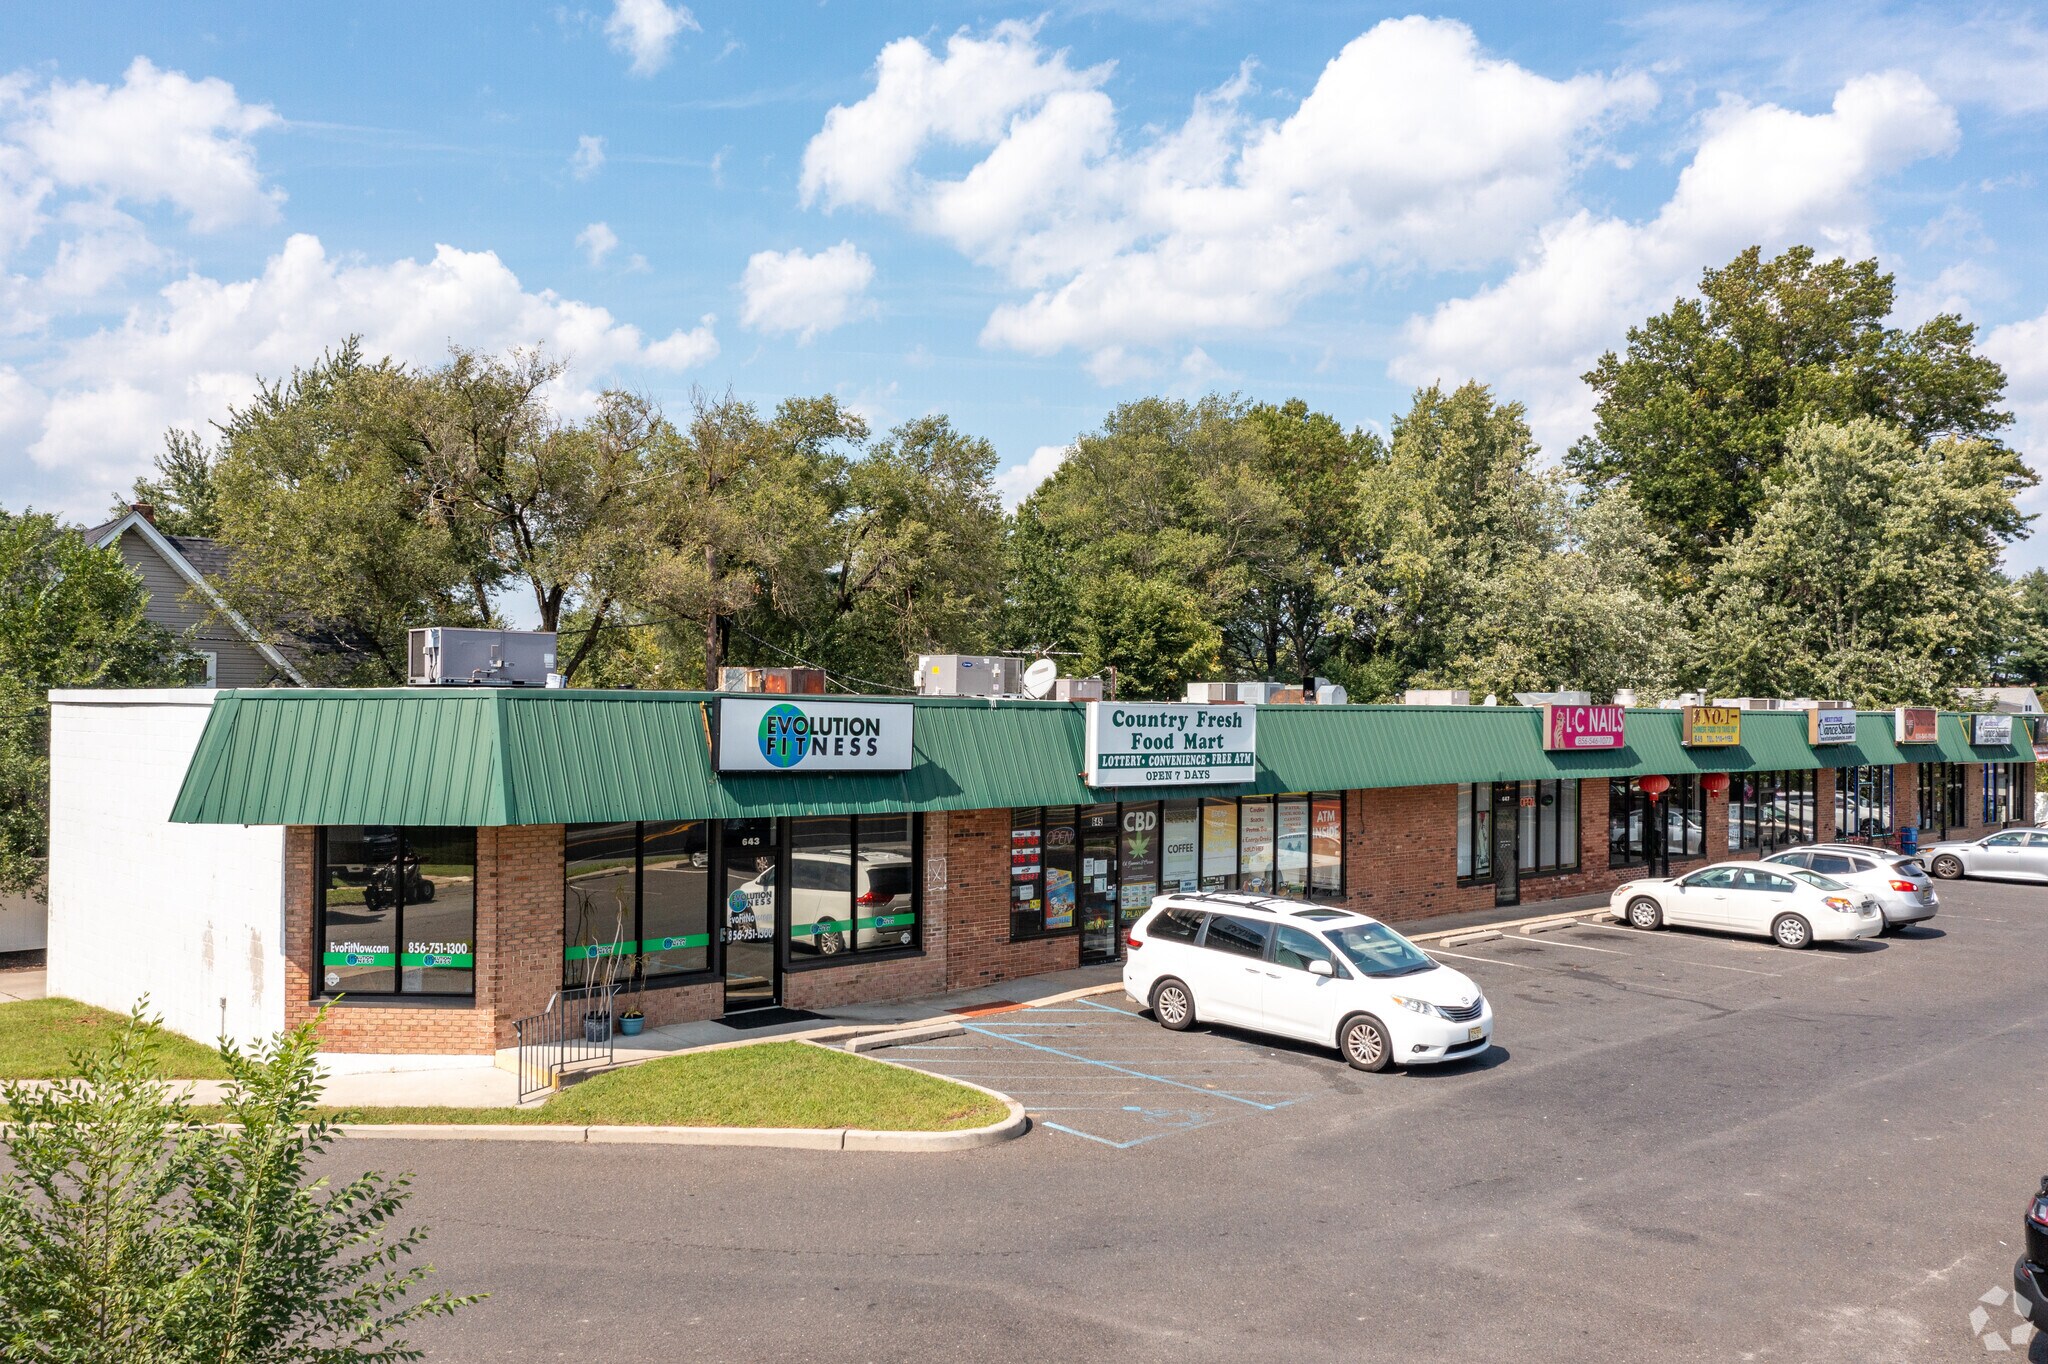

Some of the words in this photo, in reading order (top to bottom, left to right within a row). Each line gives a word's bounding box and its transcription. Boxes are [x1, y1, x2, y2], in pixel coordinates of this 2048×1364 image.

[767, 716, 880, 736] EVOLUTION
[1112, 709, 1188, 731] Country
[1196, 711, 1243, 728] Fresh
[1589, 708, 1624, 733] NAILS
[767, 737, 878, 756] FITNESS
[1131, 733, 1174, 750] Food
[1184, 733, 1224, 750] Mart
[1211, 754, 1232, 765] FREE
[1234, 753, 1251, 764] ATM
[1146, 771, 1172, 781] OPEN
[1175, 772, 1180, 780] 7
[1184, 770, 1210, 780] DAYS
[1123, 811, 1157, 832] CBD
[1317, 810, 1335, 822] ATM
[1047, 831, 1073, 844] OPEN
[1313, 826, 1339, 839] INSIDE
[742, 837, 760, 846] 643
[1168, 843, 1193, 853] COFFEE
[732, 891, 772, 901] EVOLUTION
[732, 898, 771, 907] FITNESS
[728, 928, 773, 940] 856-751-1300
[330, 942, 389, 953] EvoFitNow.com
[408, 942, 467, 953] 856-751-1300
